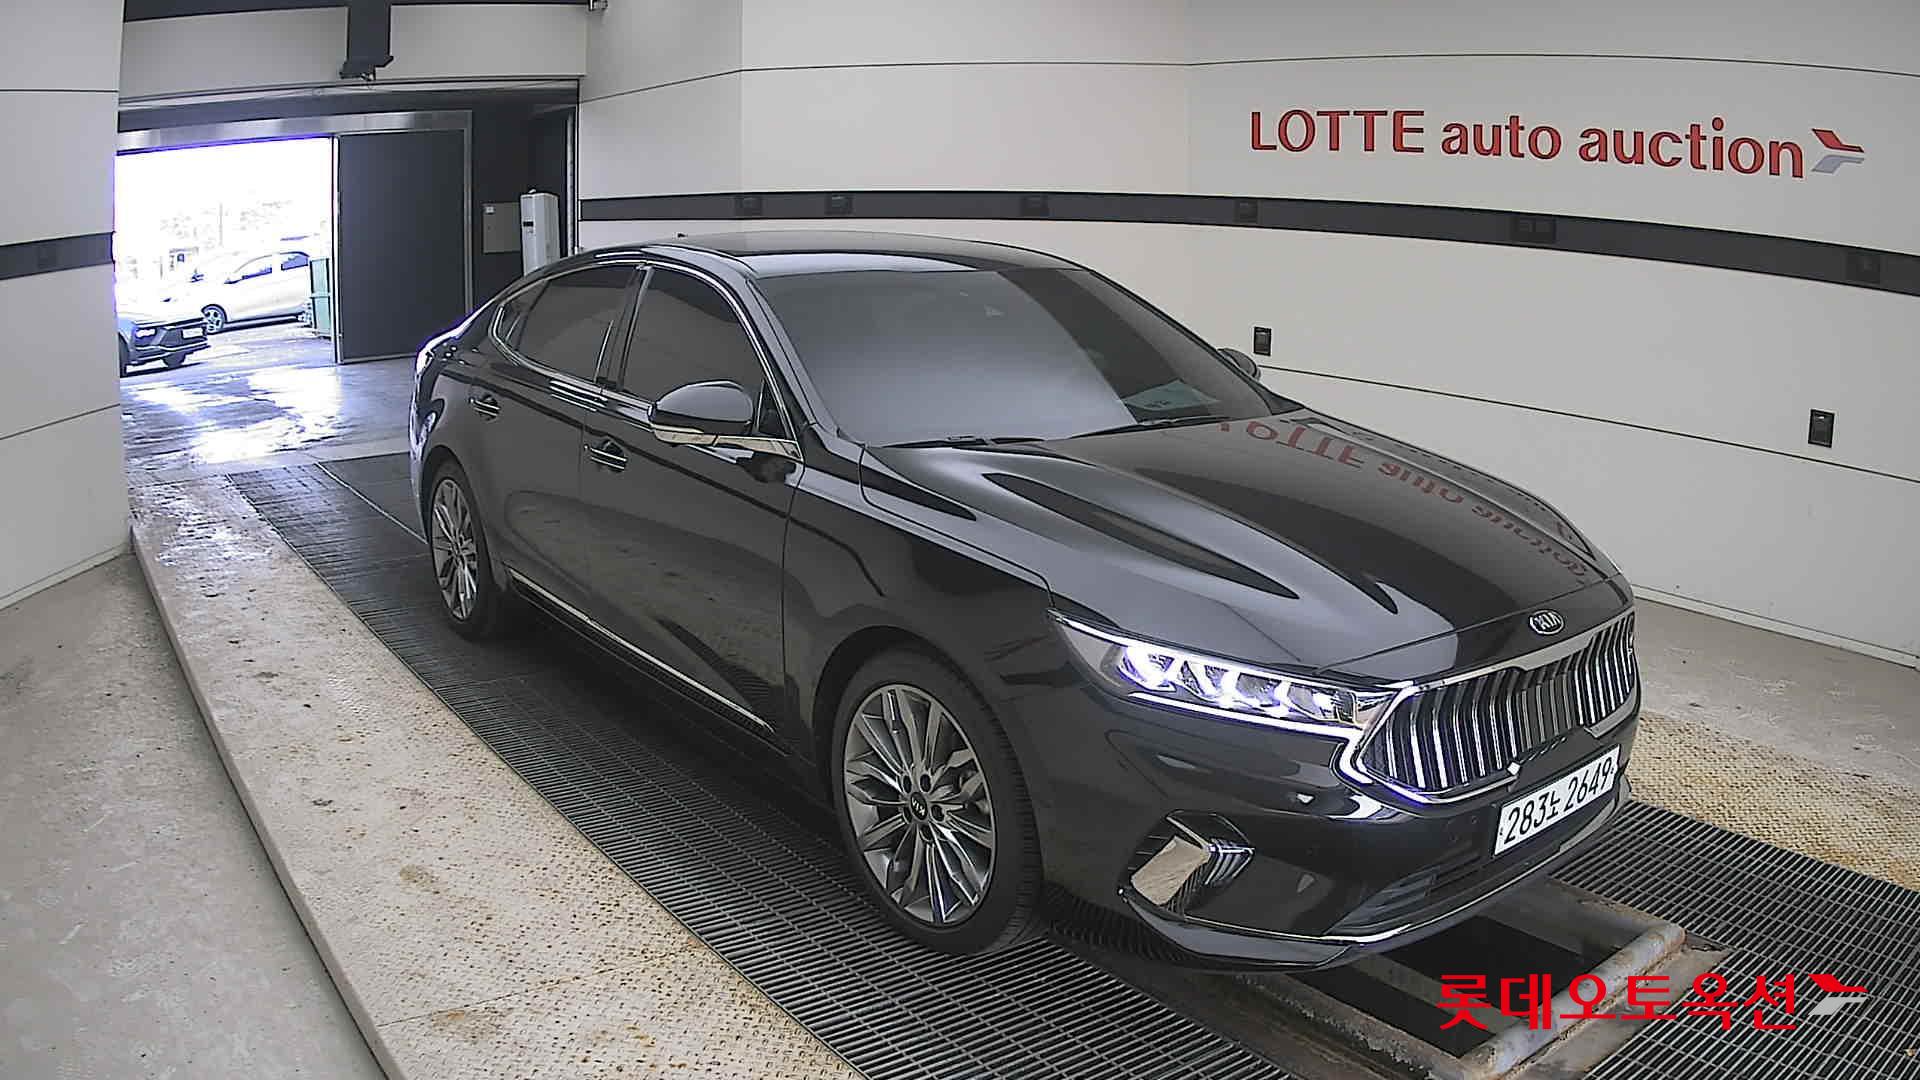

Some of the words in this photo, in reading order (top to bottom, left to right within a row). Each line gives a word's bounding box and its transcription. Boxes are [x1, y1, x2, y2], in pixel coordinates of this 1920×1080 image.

[1251, 110, 1424, 153] LOTTE
[1441, 116, 1562, 160] auto
[1578, 117, 1805, 178] auction
[1504, 790, 1561, 845] 283노
[1563, 757, 1613, 812] 2649
